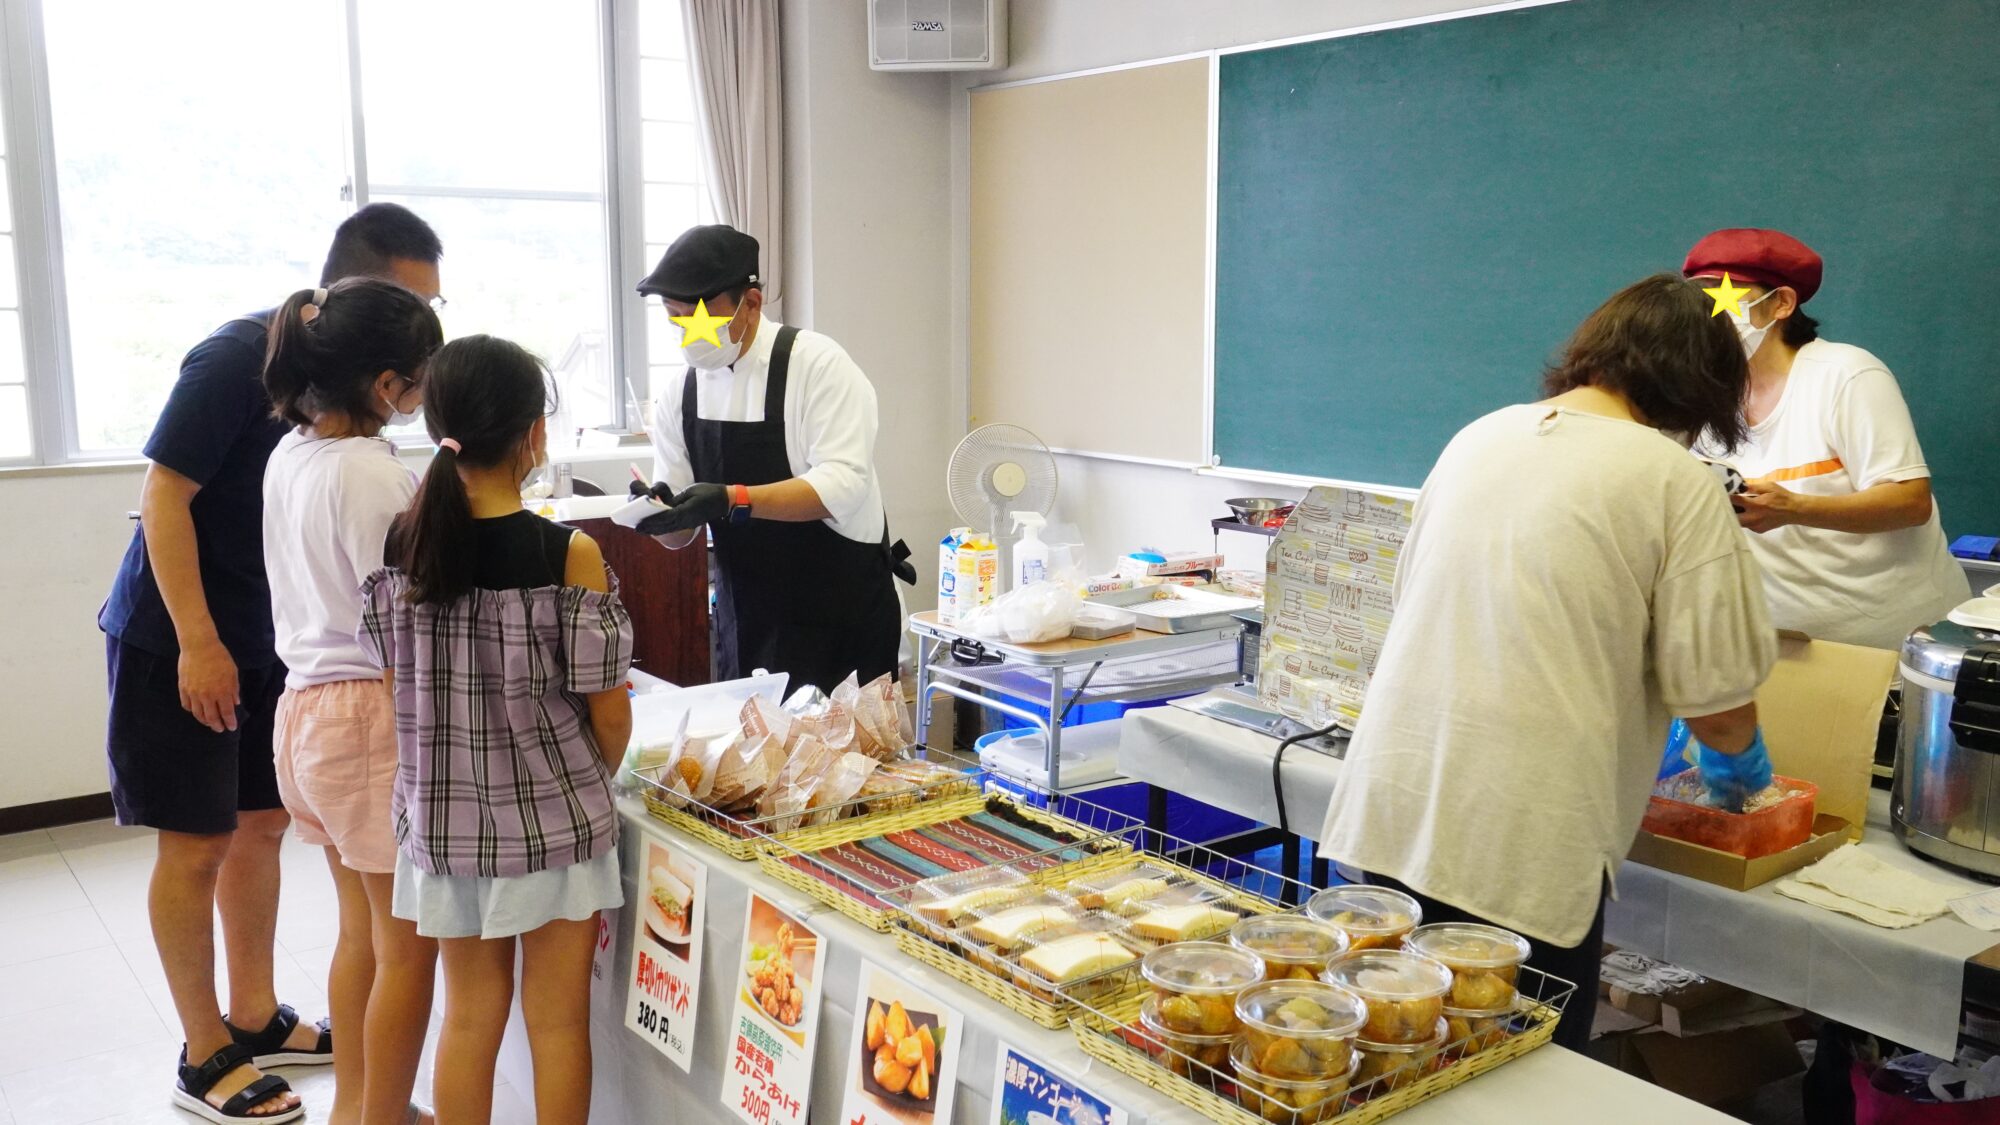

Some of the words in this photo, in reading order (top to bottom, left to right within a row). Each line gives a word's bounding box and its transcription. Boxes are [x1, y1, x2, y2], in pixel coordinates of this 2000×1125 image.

[912, 21, 944, 31] RAMSA
[1088, 584, 1110, 593] Color
[1335, 638, 1358, 654] Plates
[637, 1001, 657, 1033] 380
[659, 1016, 669, 1043] 円
[735, 1055, 801, 1119] からあげ
[741, 1085, 770, 1125] 500円
[1005, 1056, 1113, 1125] 濃厚マンゴージュー
